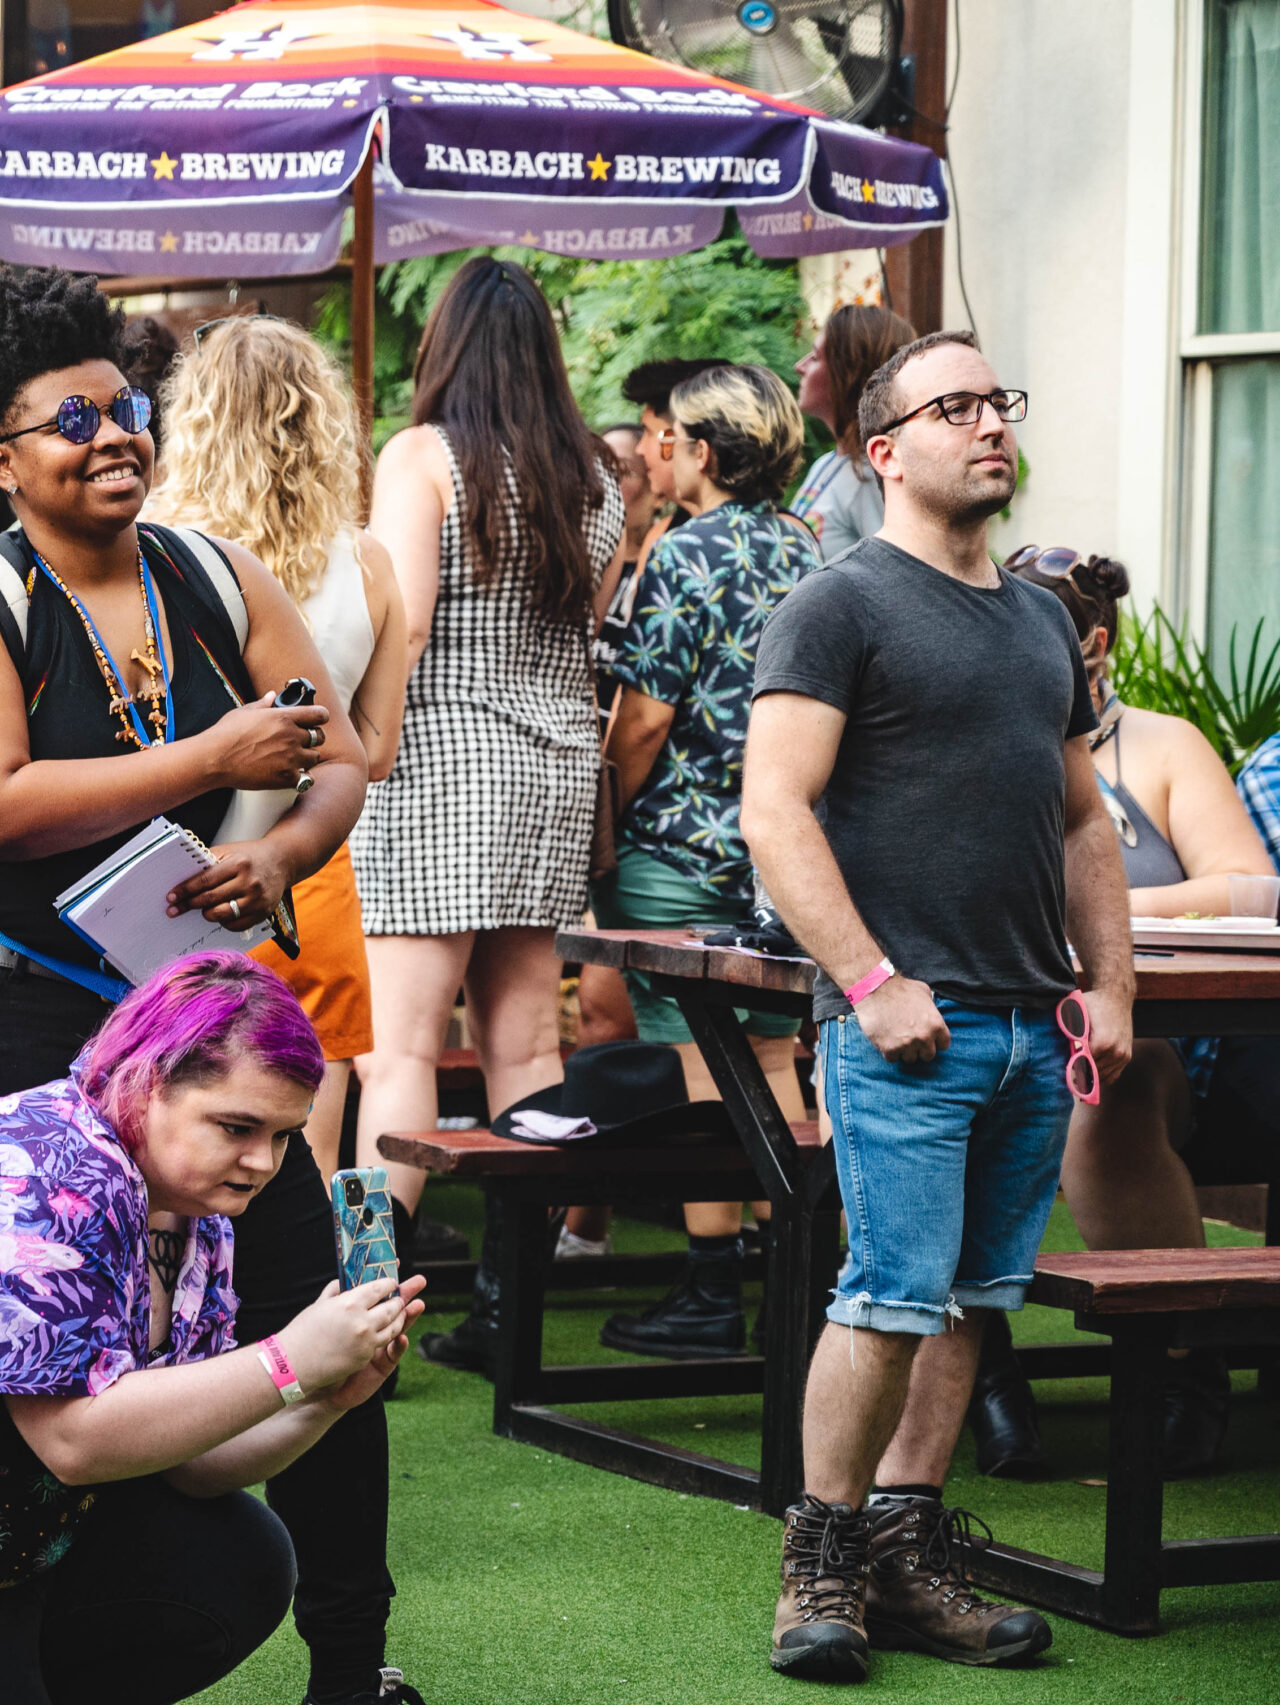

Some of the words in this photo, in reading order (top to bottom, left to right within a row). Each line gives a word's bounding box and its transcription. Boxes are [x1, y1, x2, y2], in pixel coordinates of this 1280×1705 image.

[5, 84, 237, 103] Crawford
[240, 77, 369, 98] Bock
[391, 75, 620, 101] Crawford
[180, 149, 346, 181] BREWING
[424, 143, 584, 180] KARBACH
[614, 153, 781, 185] BREWING
